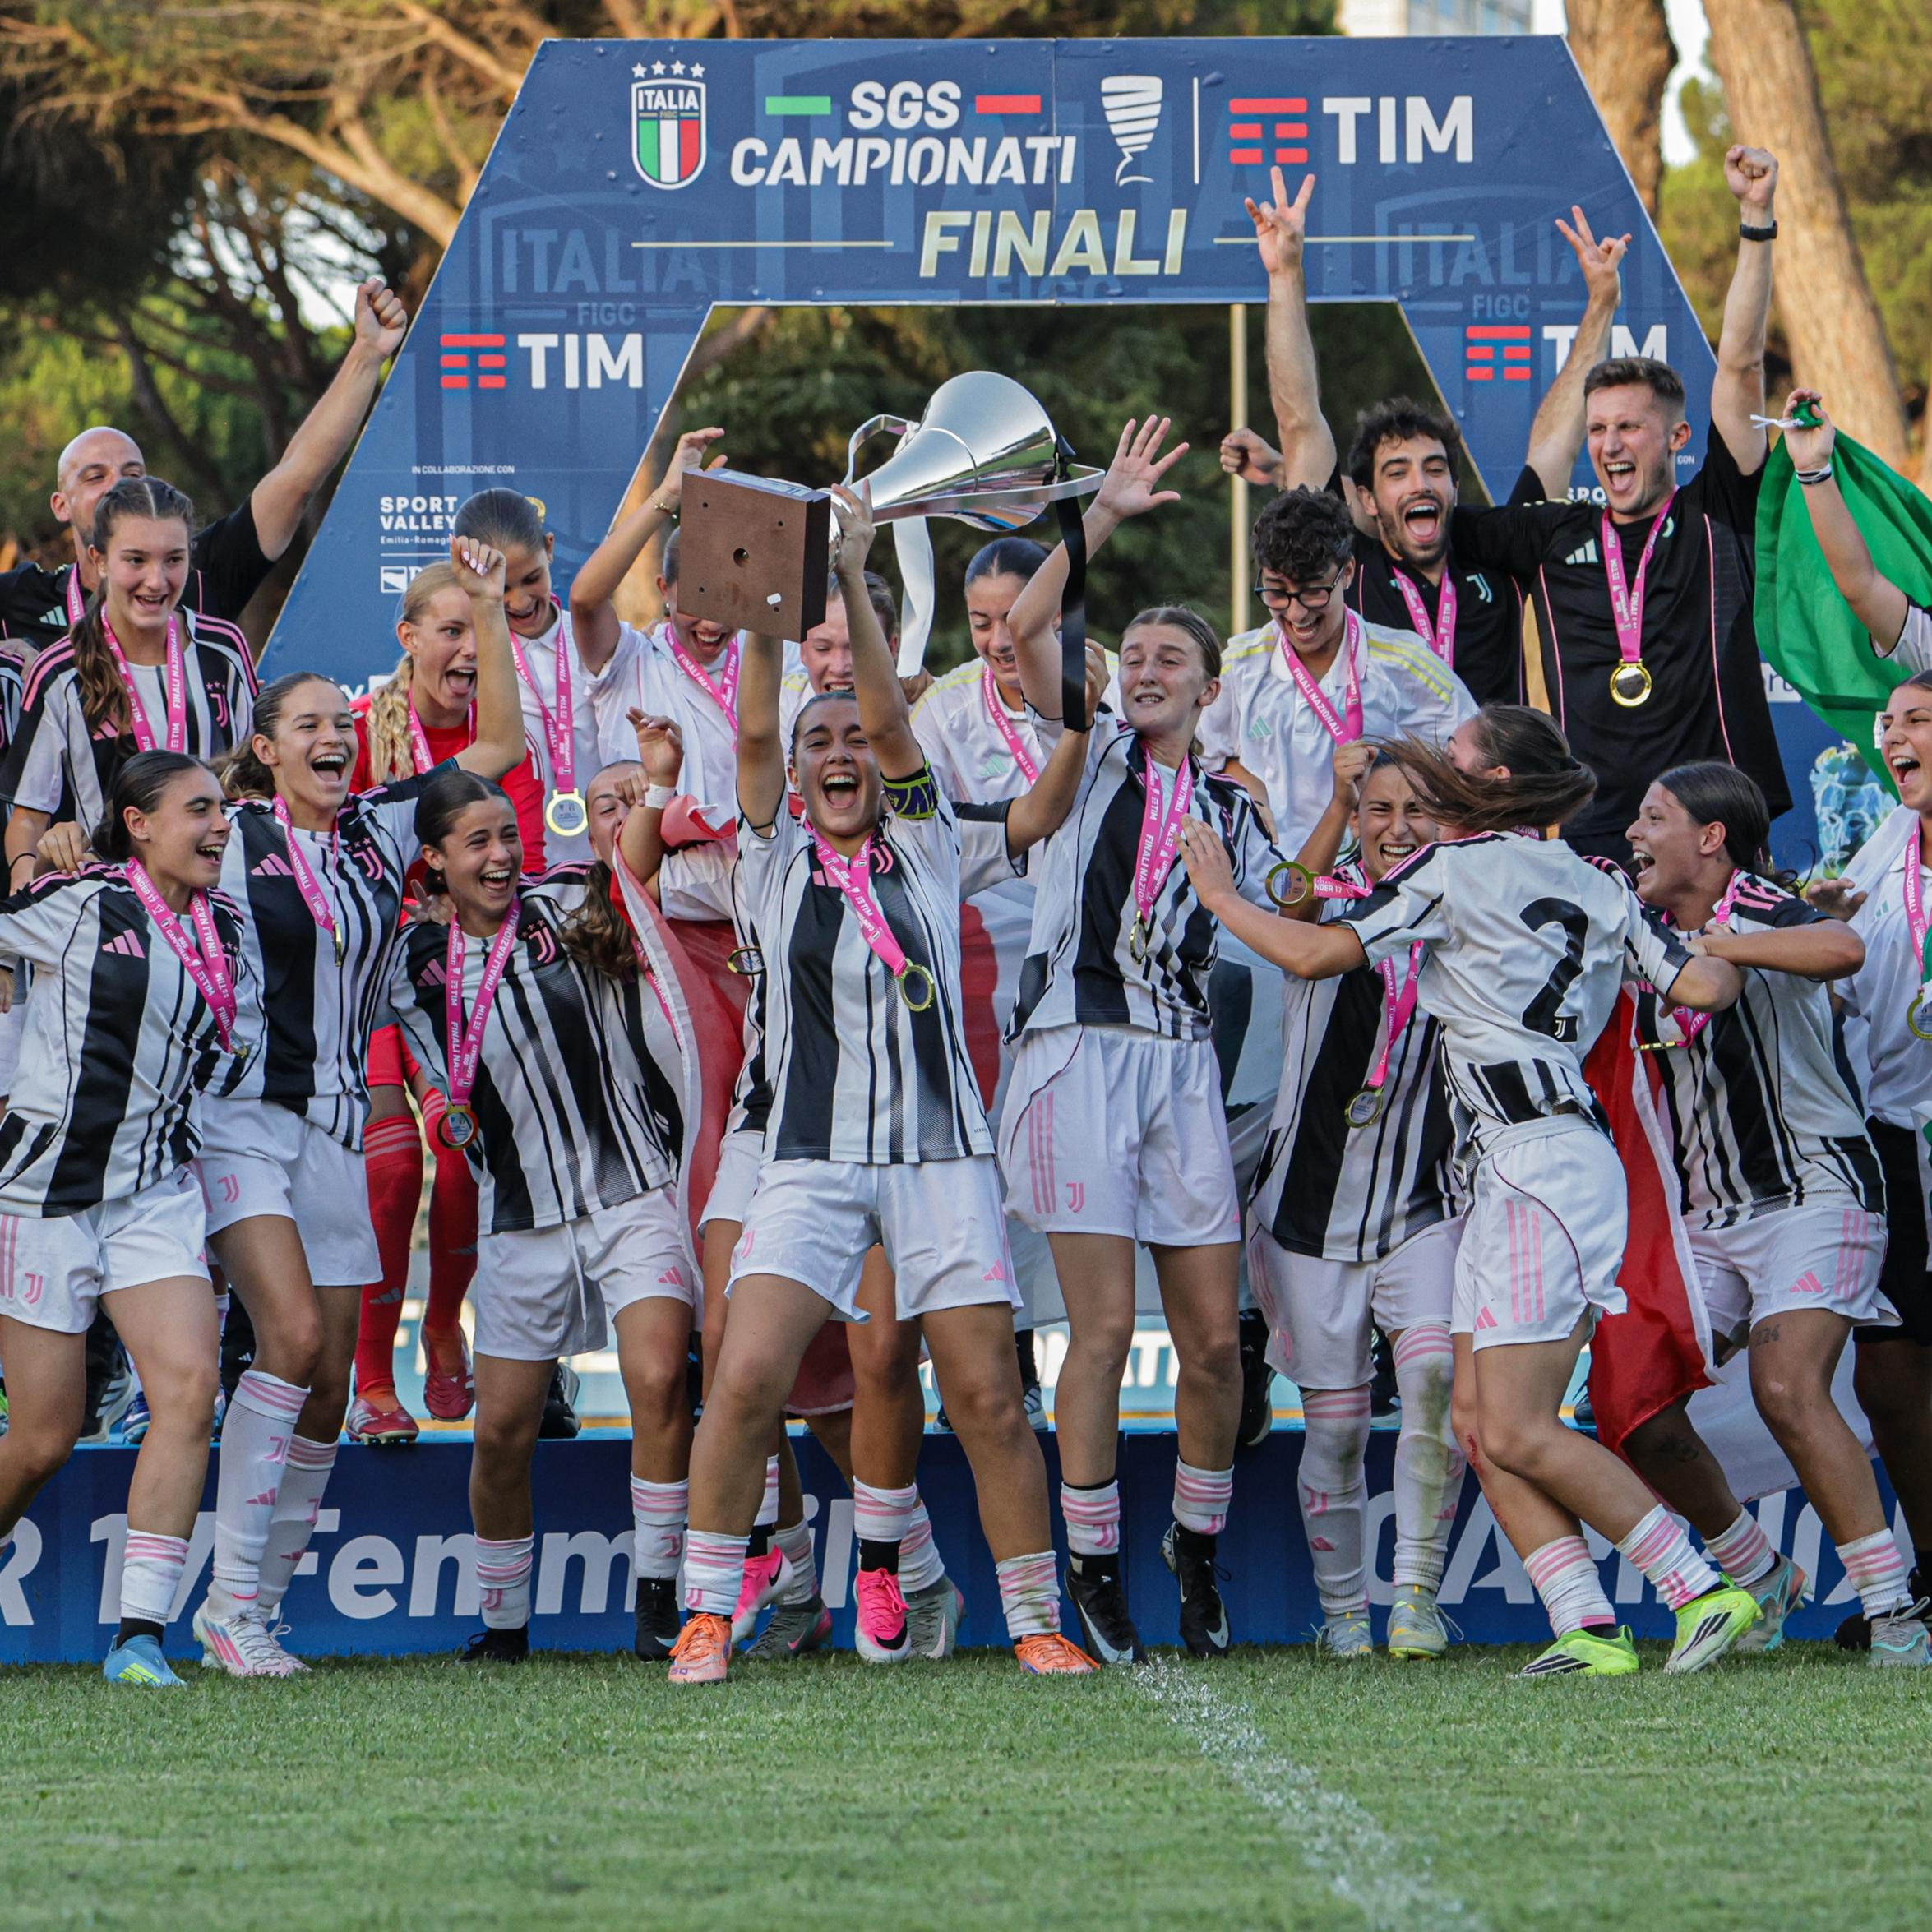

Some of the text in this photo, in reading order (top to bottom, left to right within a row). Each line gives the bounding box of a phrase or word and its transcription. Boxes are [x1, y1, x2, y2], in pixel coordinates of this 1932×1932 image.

[638, 89, 700, 110] ITALIA
[848, 81, 961, 130] SGS
[1322, 95, 1473, 164] TIM
[730, 136, 1076, 186] CAMPIONATI
[919, 209, 1188, 278] FINALI
[575, 301, 636, 326] FIGC
[517, 333, 644, 390] TIM
[1542, 325, 1668, 376] TM
[412, 465, 515, 474] IN COLLABORAZIONE CON
[380, 496, 458, 513] SPORT
[380, 515, 457, 530] VALLEY
[380, 535, 451, 546] Emilia-Romag
[1293, 667, 1343, 737] FINALI NAZIONALI
[1143, 834, 1154, 867] FINALI
[1315, 883, 1333, 894] NDER
[202, 926, 219, 959] FINALI
[485, 909, 520, 991] FINALI NAZIONALI
[1519, 896, 1589, 1042] 2
